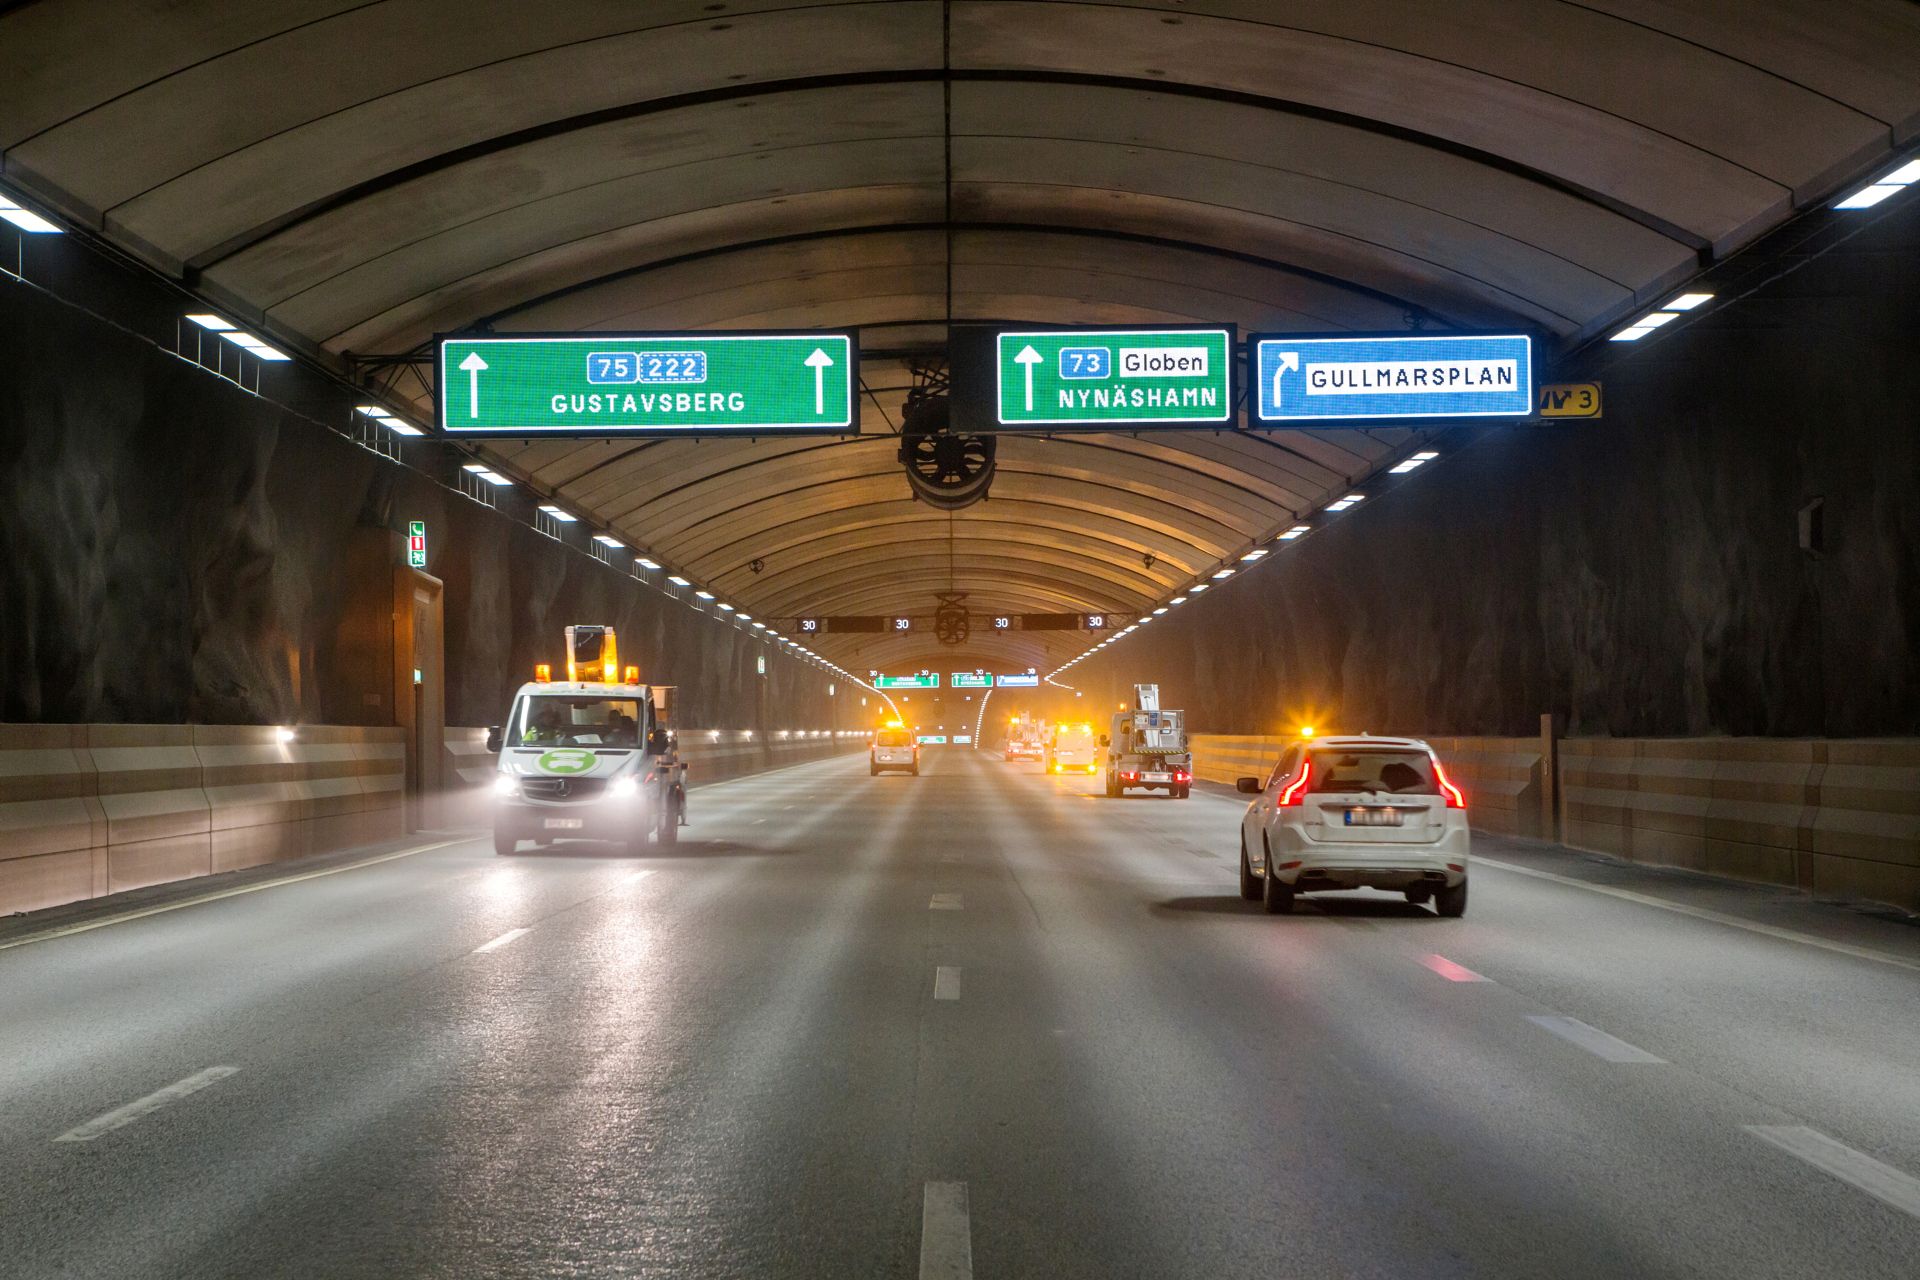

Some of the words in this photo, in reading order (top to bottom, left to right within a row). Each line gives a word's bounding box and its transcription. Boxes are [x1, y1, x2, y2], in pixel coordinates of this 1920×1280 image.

[597, 358, 629, 378] 75
[649, 357, 697, 377] 222
[1069, 353, 1101, 373] 73
[1125, 353, 1203, 371] Globen
[1311, 366, 1512, 388] GULLMARSPLAN
[551, 392, 746, 413] GUSTAVSBERG
[1058, 384, 1217, 408] NYNÄSHAMN
[1579, 390, 1592, 409] 3
[802, 620, 816, 631] 30
[895, 619, 909, 629] 30
[995, 617, 1009, 628] 30
[1089, 616, 1103, 627] 30
